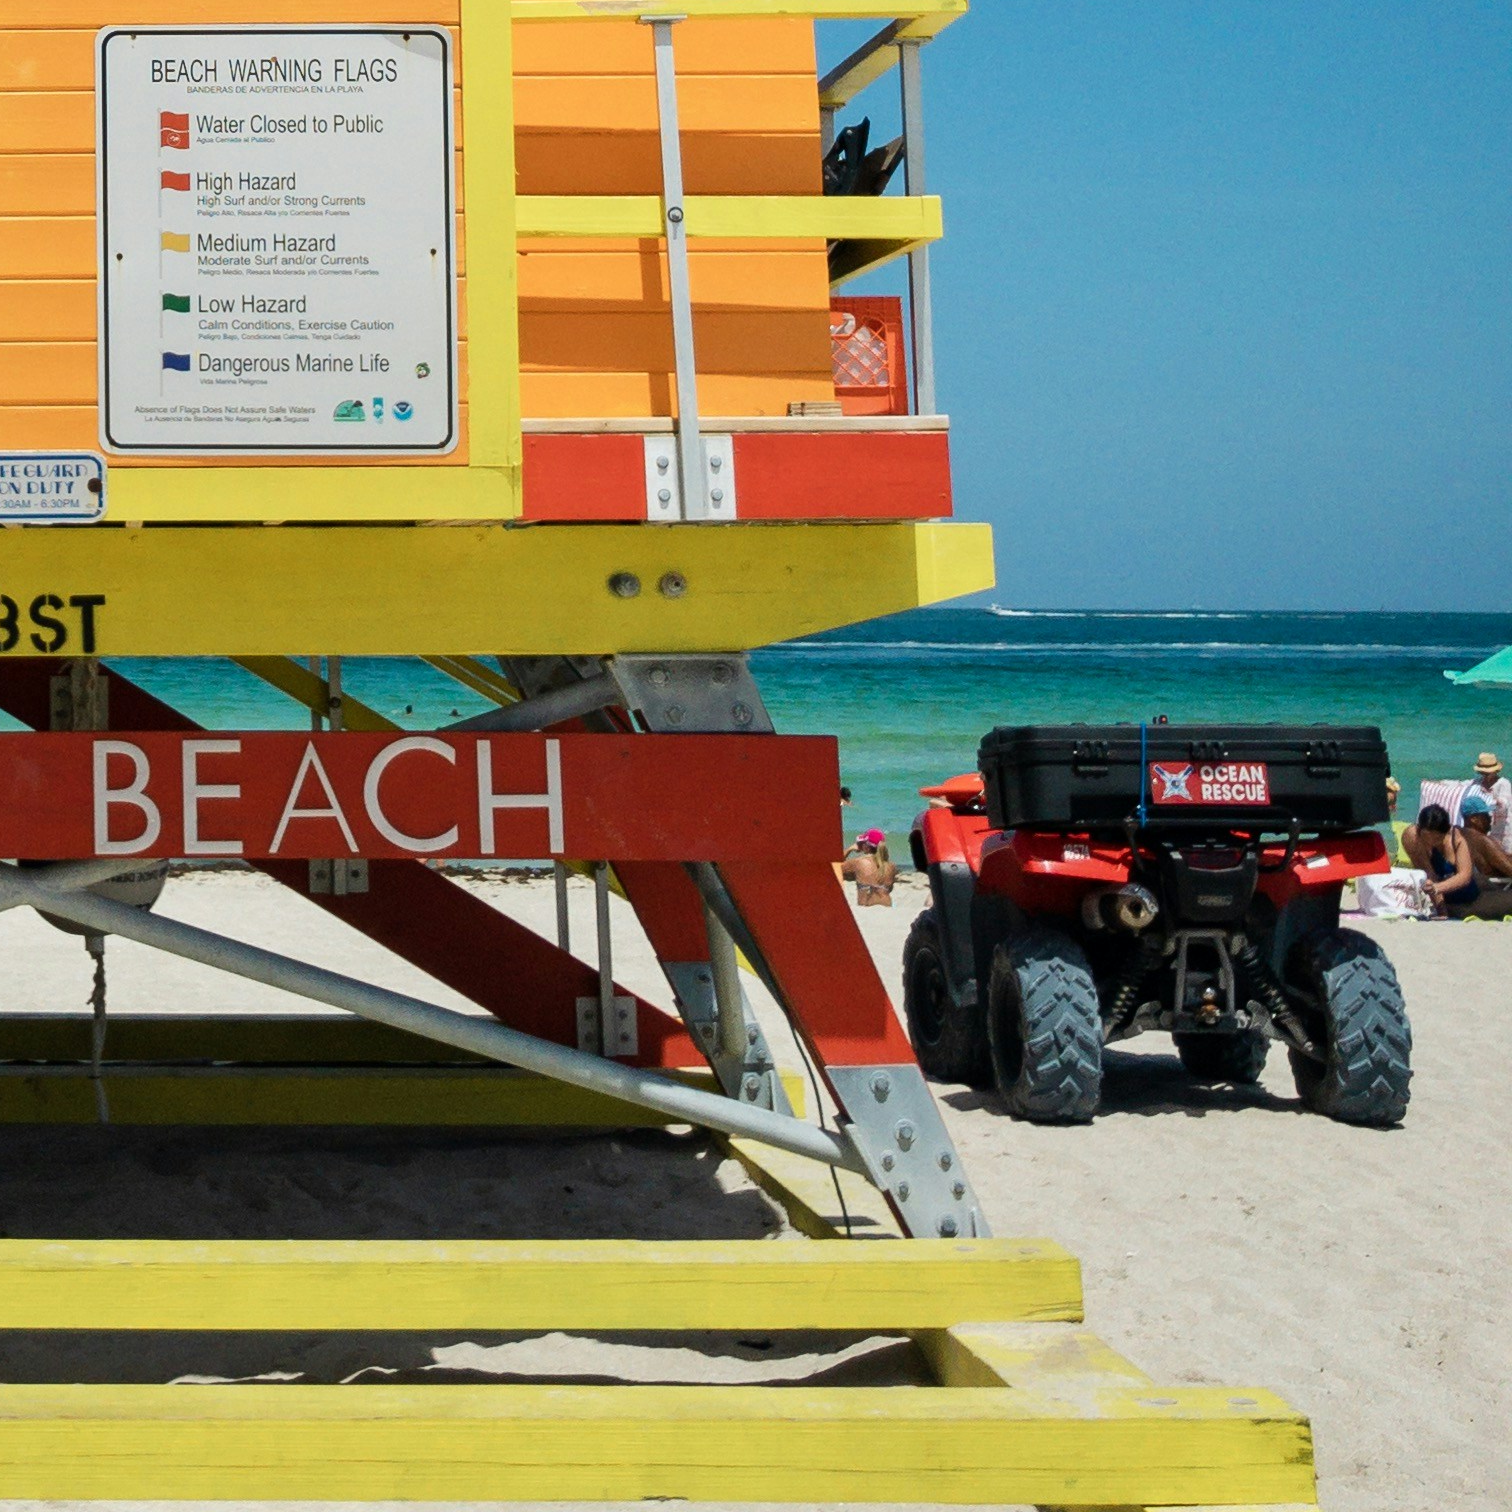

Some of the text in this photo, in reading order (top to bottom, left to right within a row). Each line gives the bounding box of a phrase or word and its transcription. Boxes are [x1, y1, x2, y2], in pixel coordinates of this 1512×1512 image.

[151, 58, 398, 83] BEACH WARNING FLAGS
[187, 85, 363, 93] BANDERAS DE ADVERTENCIA EN LA PLAYA
[196, 114, 384, 133] Water Closed to Public
[197, 172, 296, 196] High Hazard
[197, 195, 366, 208] High Surf and/or Strong Currents
[197, 234, 336, 252] Medium Hazard
[197, 255, 369, 266] Moderate Surf and/or Currents
[198, 295, 306, 313] Low Hazard
[198, 320, 394, 331] Calm Conditions, Exercise Caution
[199, 353, 390, 377] Dangerous Marine Life
[134, 406, 167, 414] Absence
[170, 406, 178, 414] of
[179, 406, 201, 415] Flags
[202, 406, 222, 414] Does
[225, 406, 239, 414] Not
[289, 406, 316, 414] Waters
[27, 481, 74, 494] DUTY
[1200, 765, 1263, 782] OCEAN
[93, 736, 565, 856] BEACH
[1201, 783, 1266, 801] RESCUE
